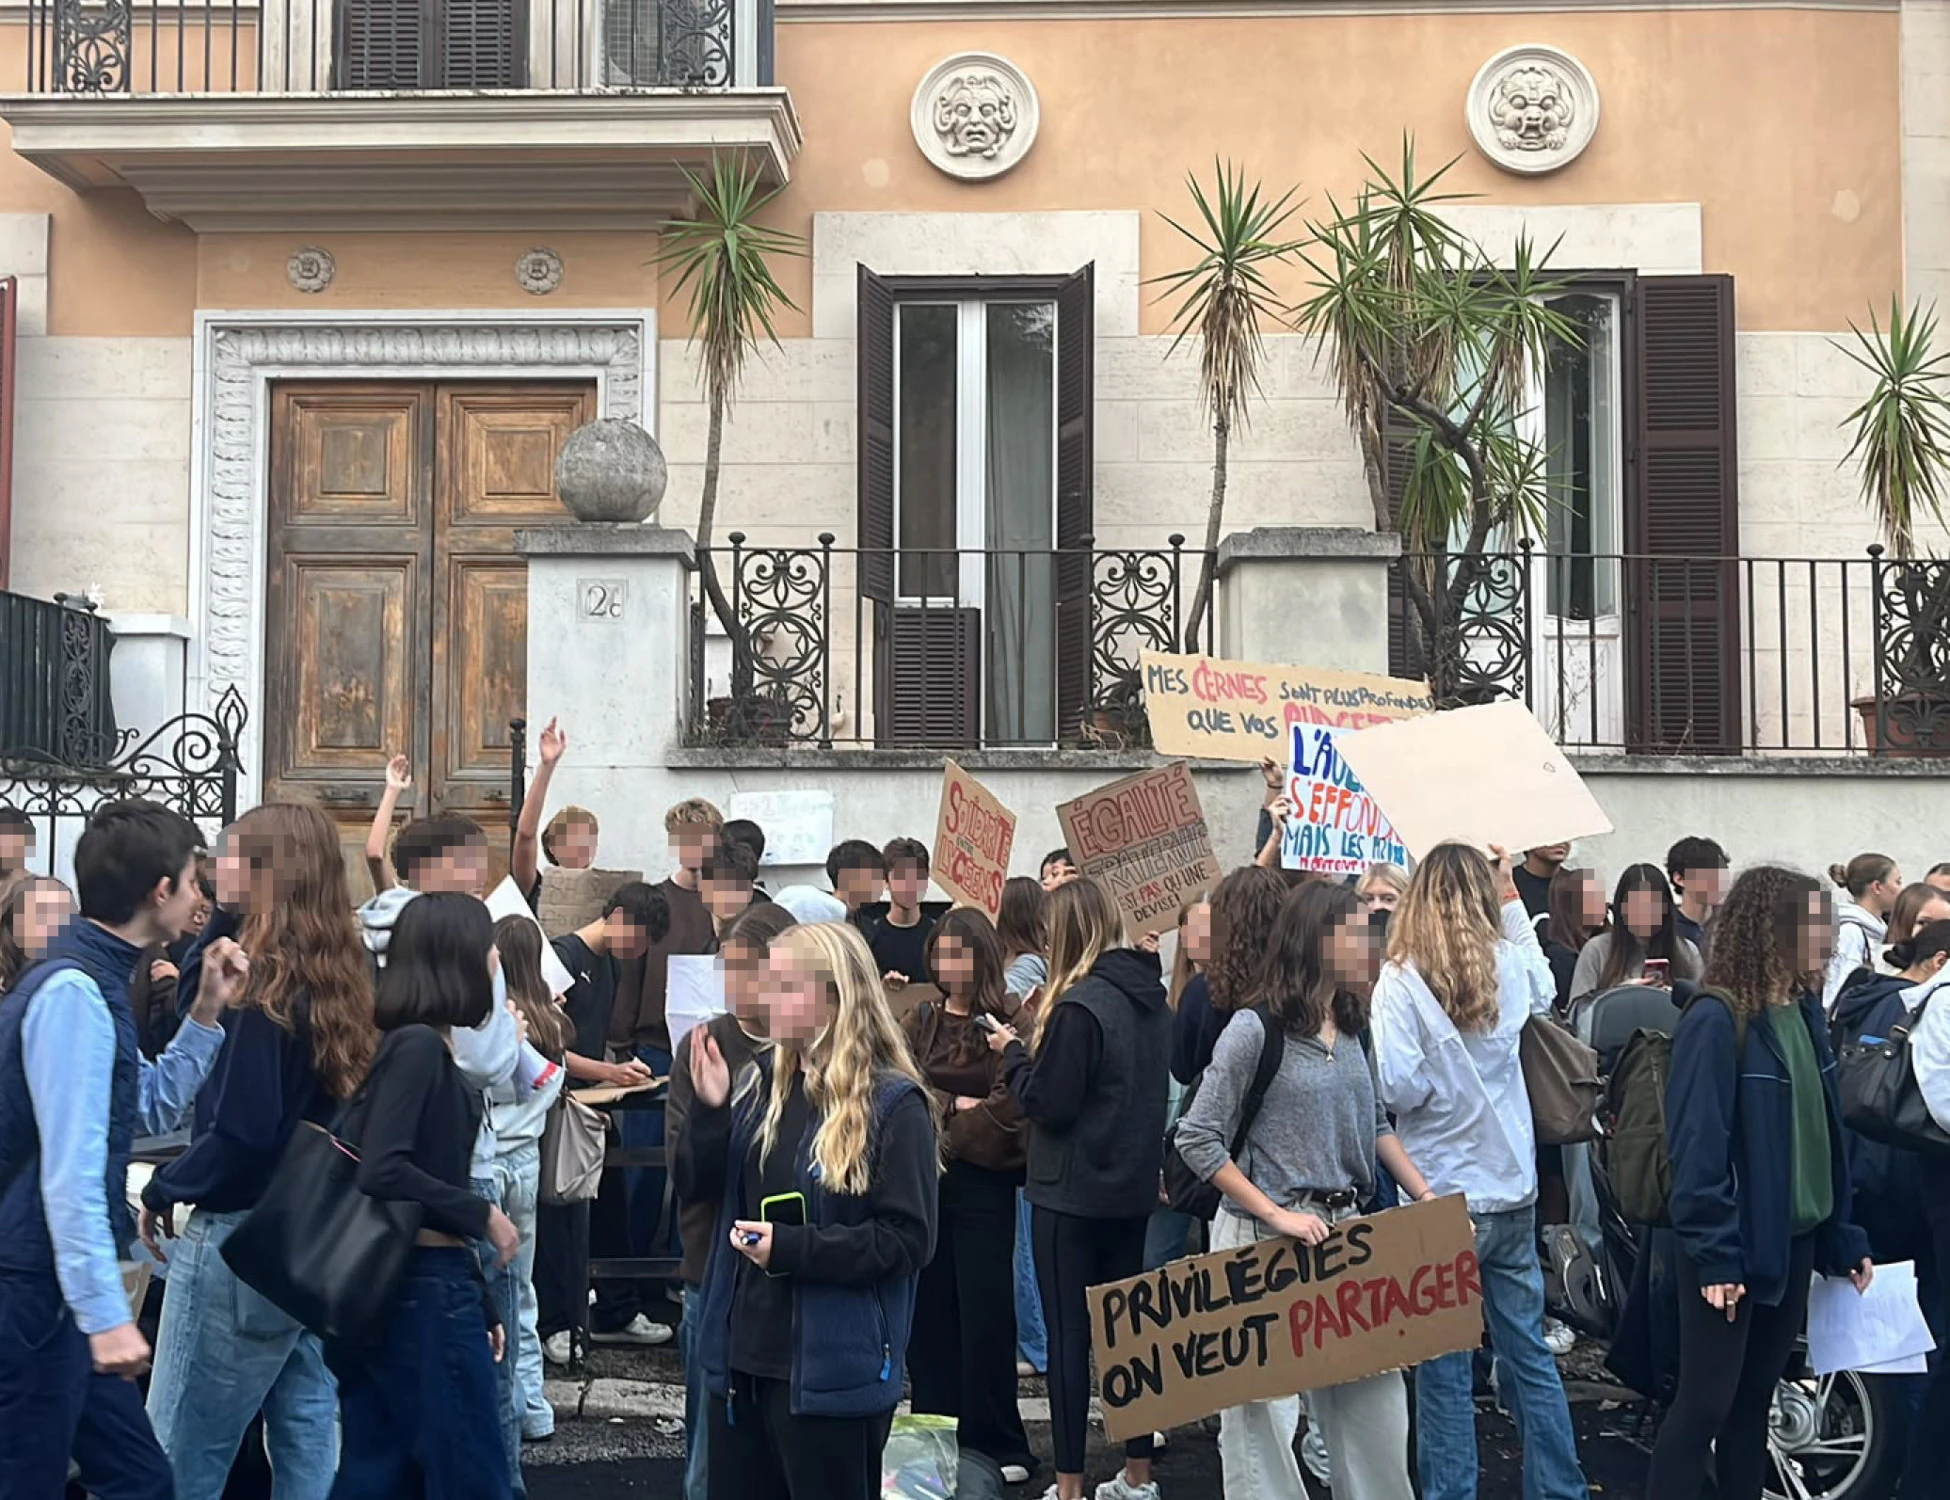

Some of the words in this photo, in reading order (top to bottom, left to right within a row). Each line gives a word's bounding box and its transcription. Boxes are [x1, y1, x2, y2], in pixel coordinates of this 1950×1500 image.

[1148, 664, 1188, 694] MES
[1193, 659, 1268, 705] CERNES
[1324, 687, 1360, 707] PLUS
[1187, 709, 1235, 735] QUE
[1240, 711, 1279, 738] VOS
[1070, 766, 1198, 859] ÉGALITÉ
[1284, 823, 1332, 857] MAIS
[1341, 831, 1364, 860] LES
[1139, 880, 1163, 901] PAS
[1102, 1343, 1162, 1408] ON
[1172, 1312, 1279, 1379] VEUT
[1288, 1250, 1483, 1358] PARTAGER
